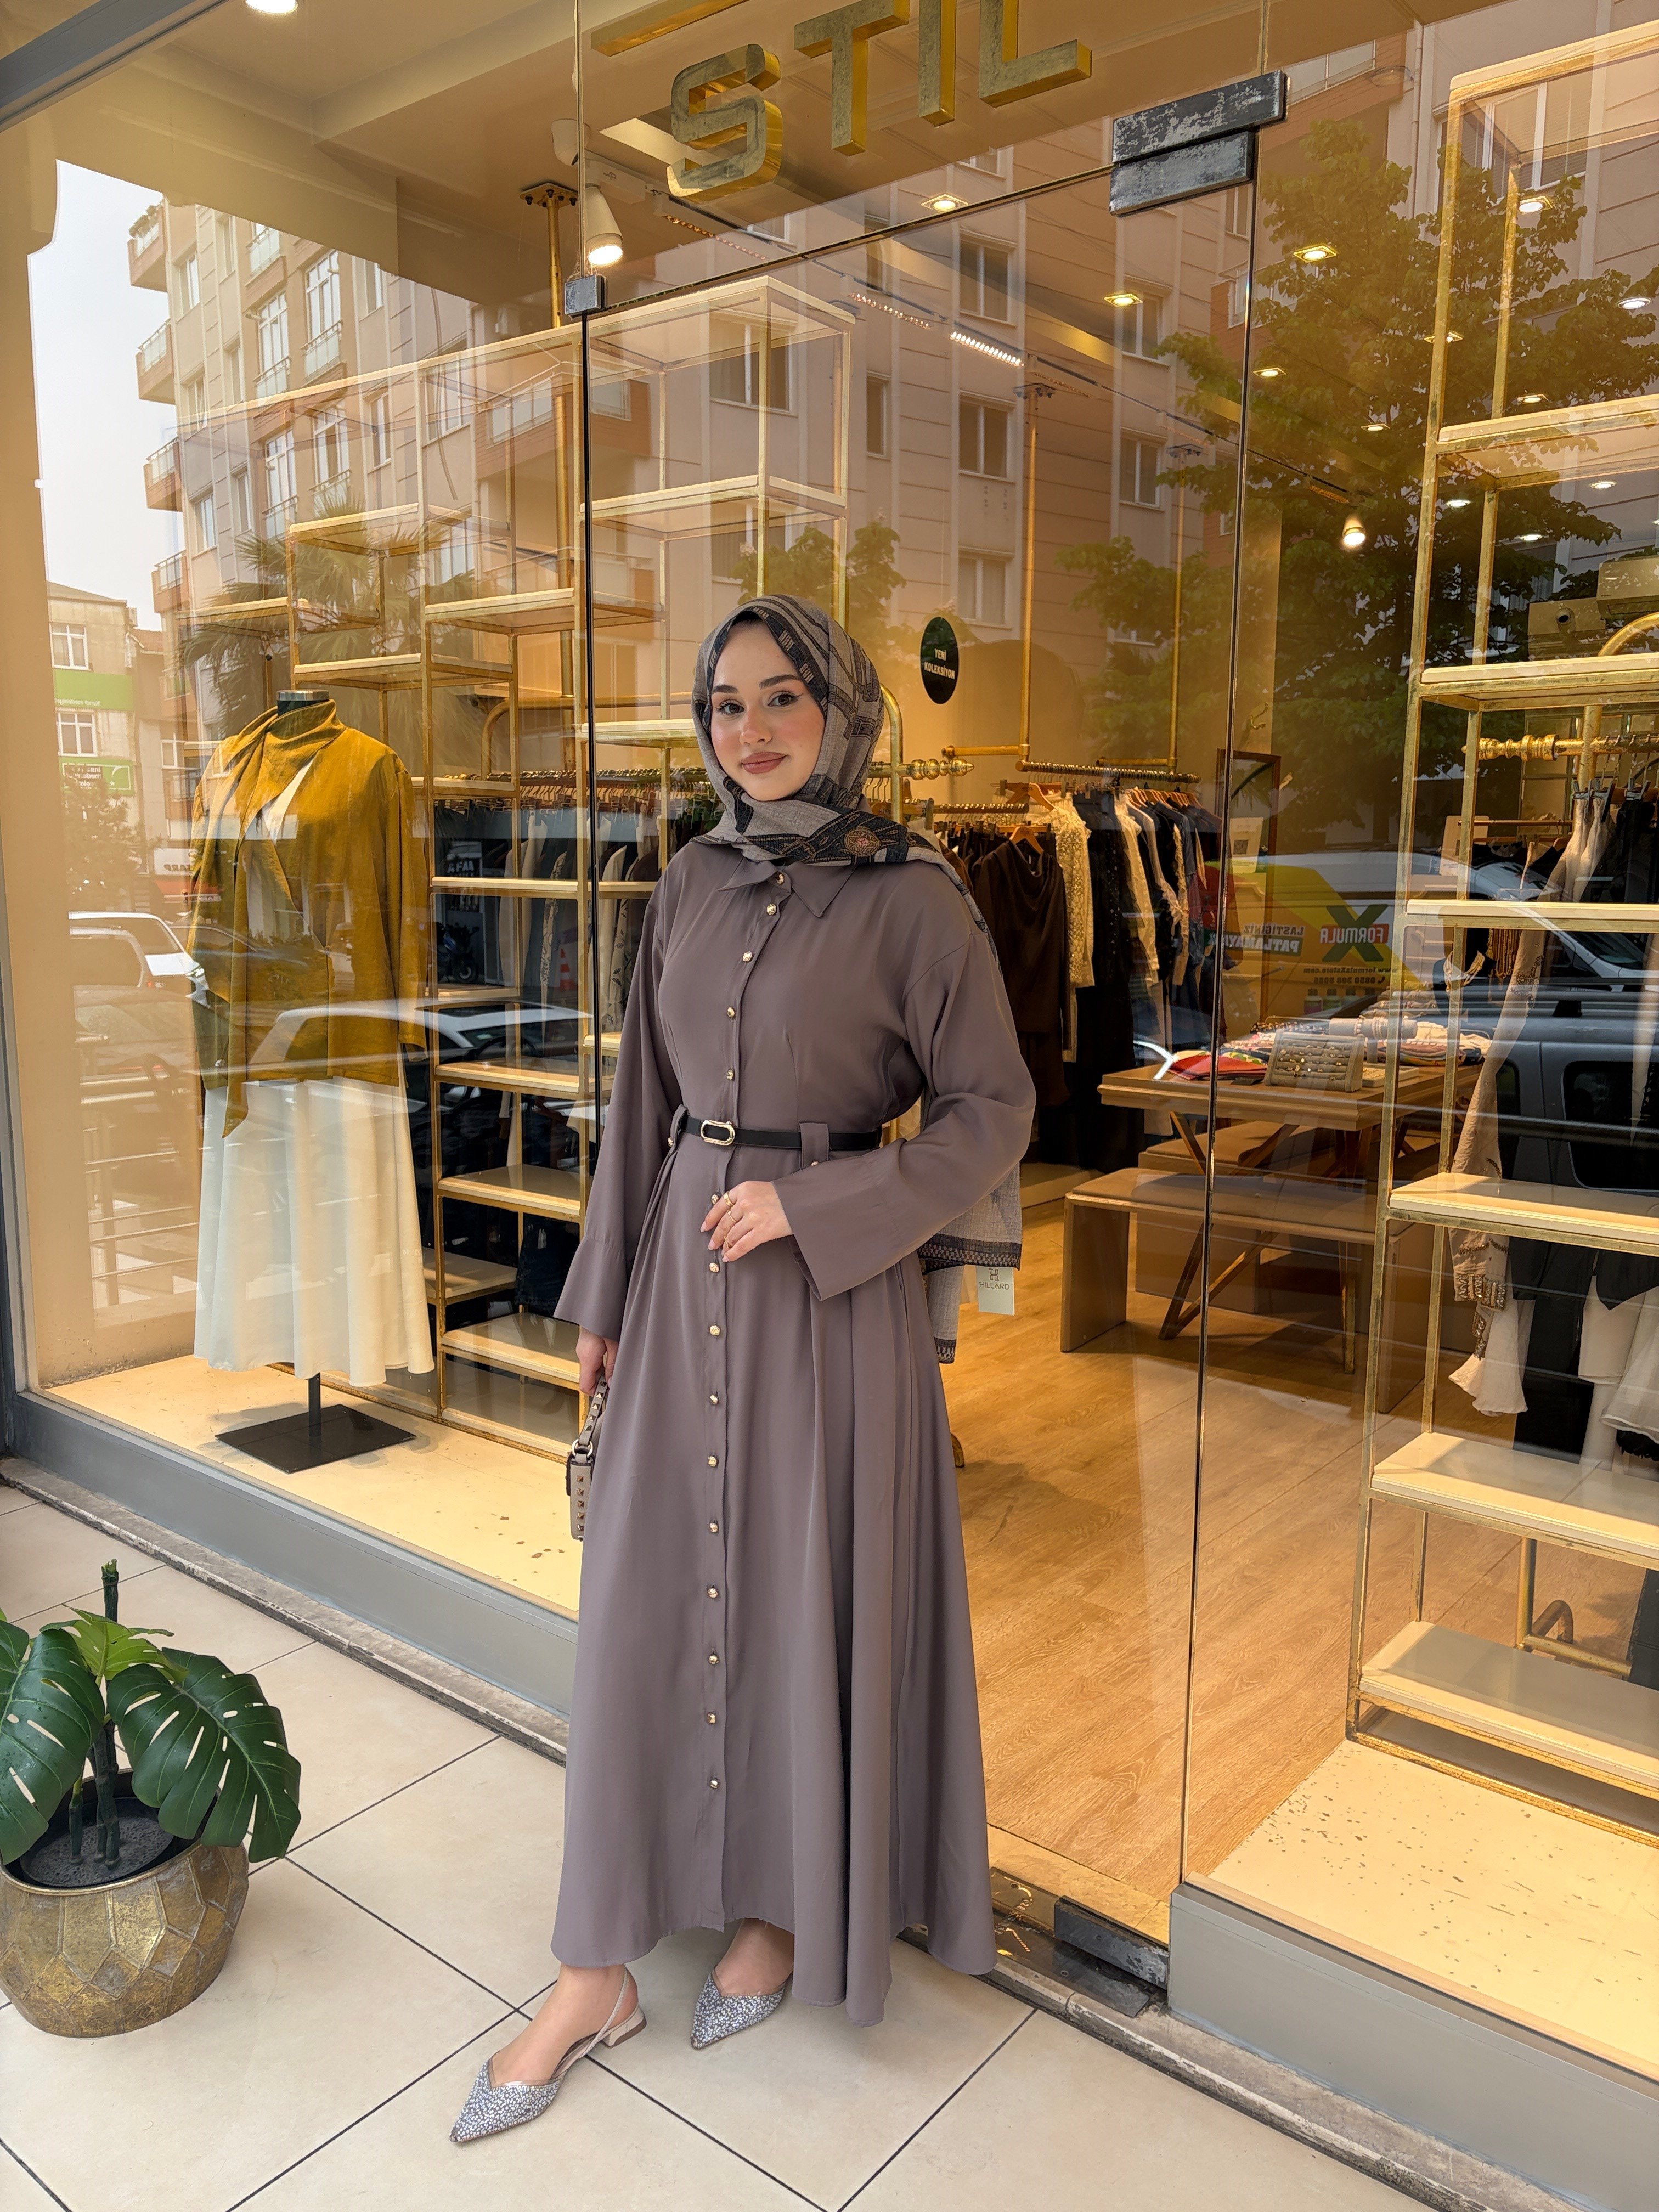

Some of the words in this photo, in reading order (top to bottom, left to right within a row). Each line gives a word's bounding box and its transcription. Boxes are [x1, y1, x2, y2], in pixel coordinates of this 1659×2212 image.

[934, 648, 946, 660] YENİ
[924, 662, 955, 679] KOLEKSİYON
[979, 1282, 1010, 1290] HILLARD
